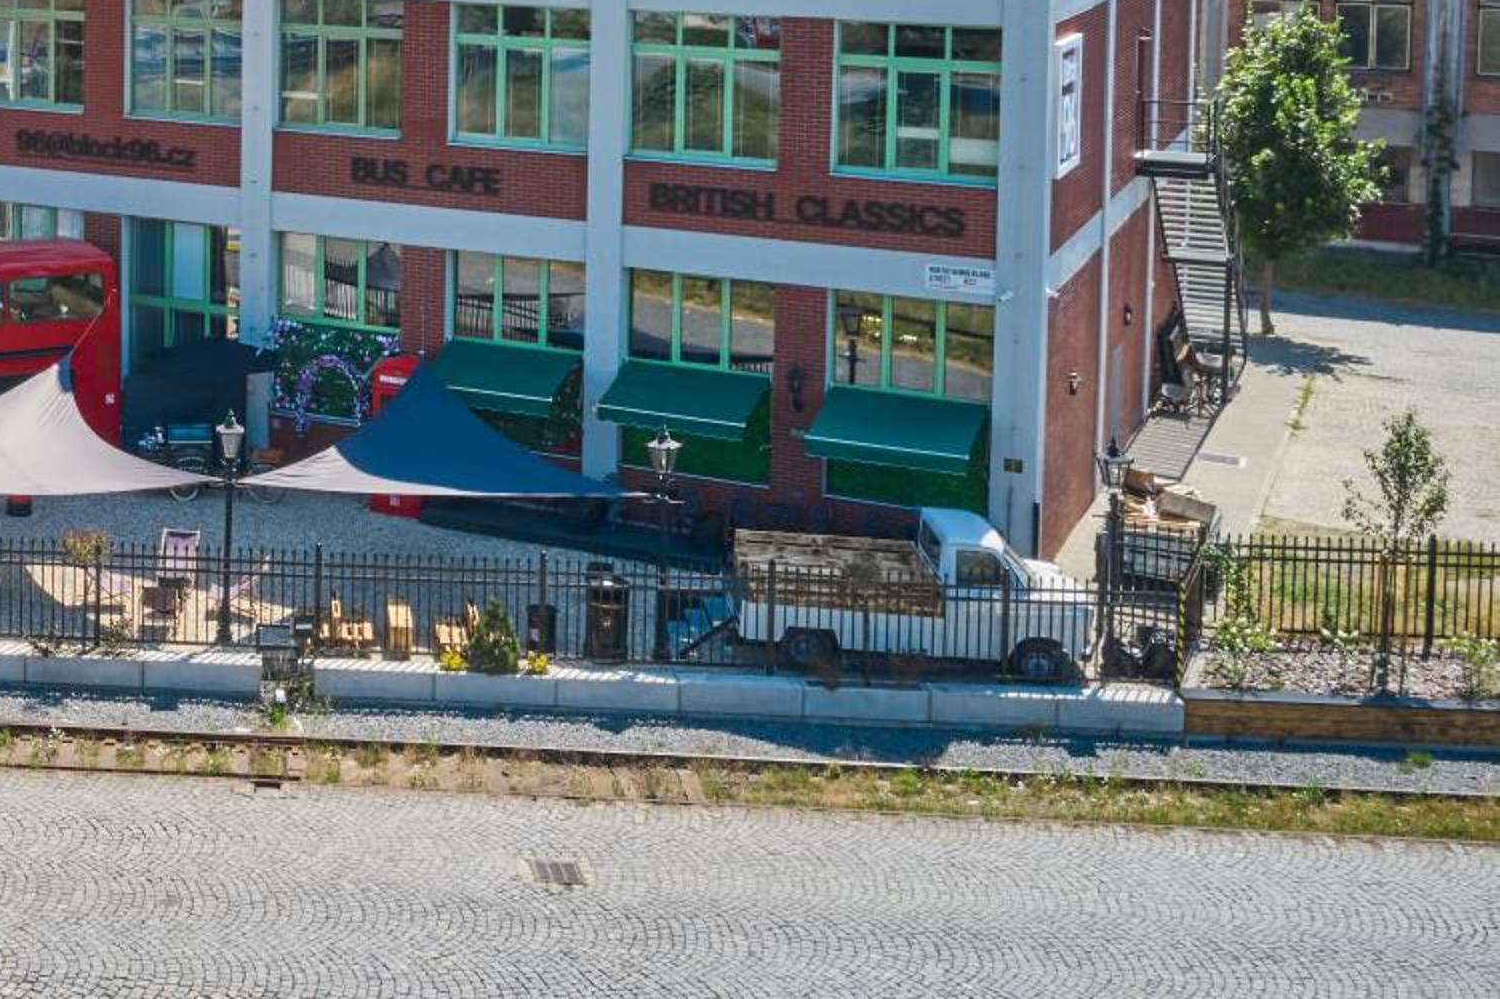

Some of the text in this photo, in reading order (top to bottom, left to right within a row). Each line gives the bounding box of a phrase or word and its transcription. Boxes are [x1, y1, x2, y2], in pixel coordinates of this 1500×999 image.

[351, 156, 408, 185] BUS
[649, 181, 966, 238] BRITISH CLASSICS
